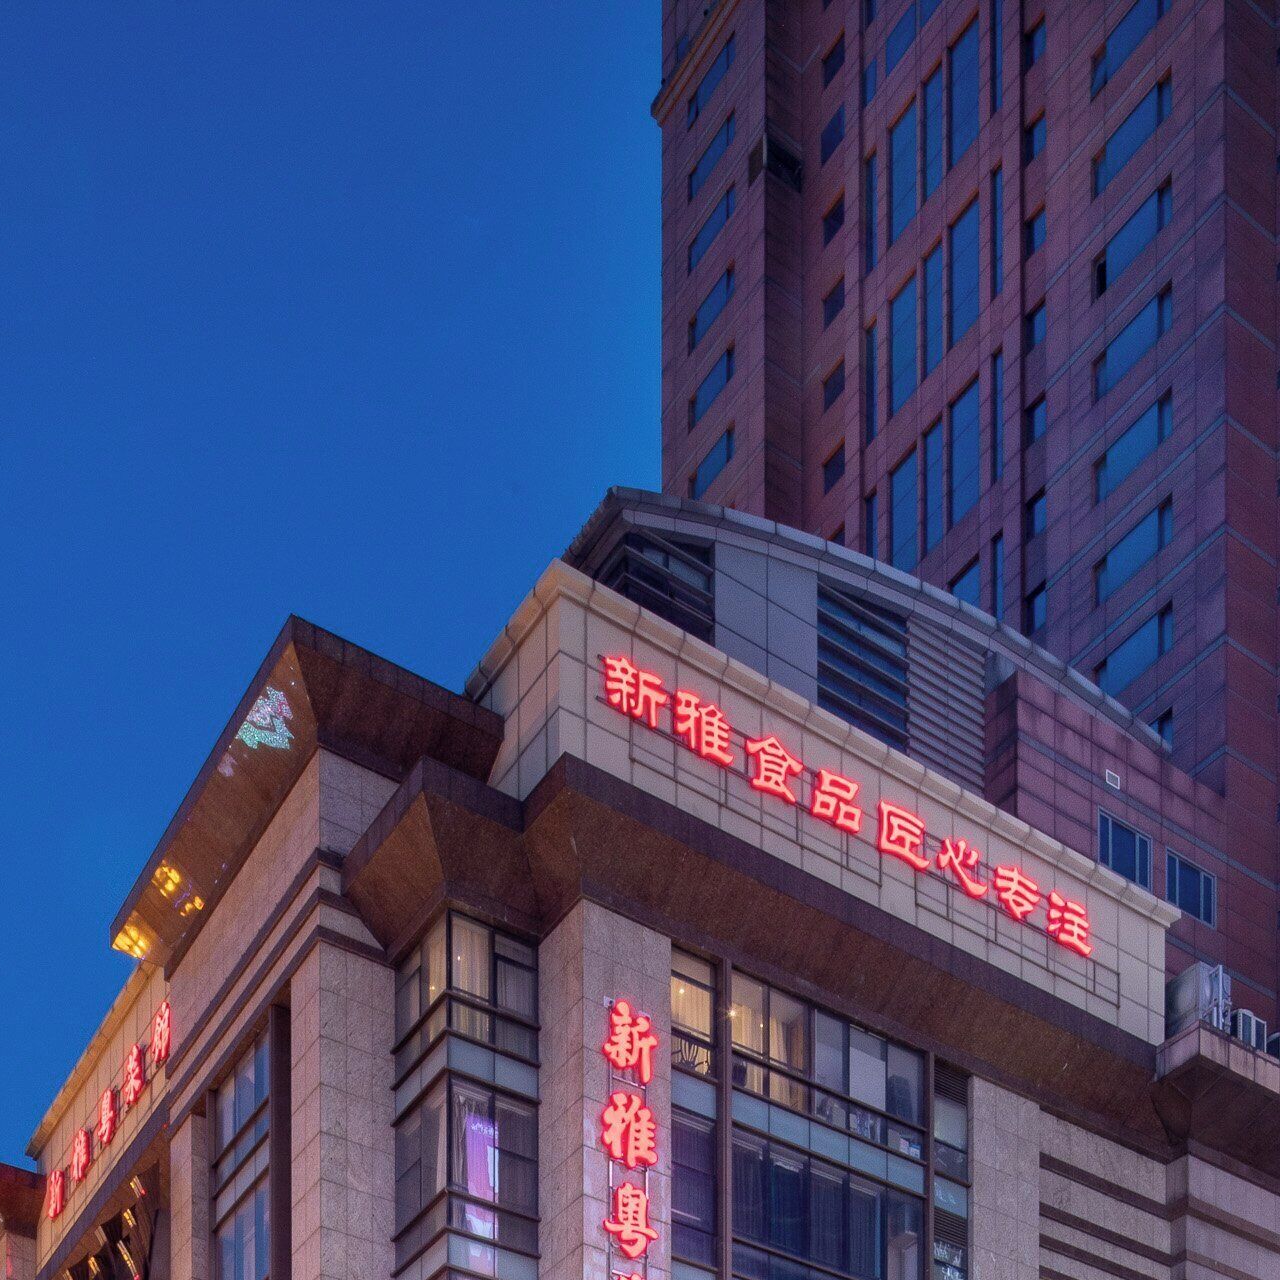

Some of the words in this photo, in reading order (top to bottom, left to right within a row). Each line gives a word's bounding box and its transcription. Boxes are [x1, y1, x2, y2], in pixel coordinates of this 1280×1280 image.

[602, 654, 1095, 958] 新雅食品匠心专注
